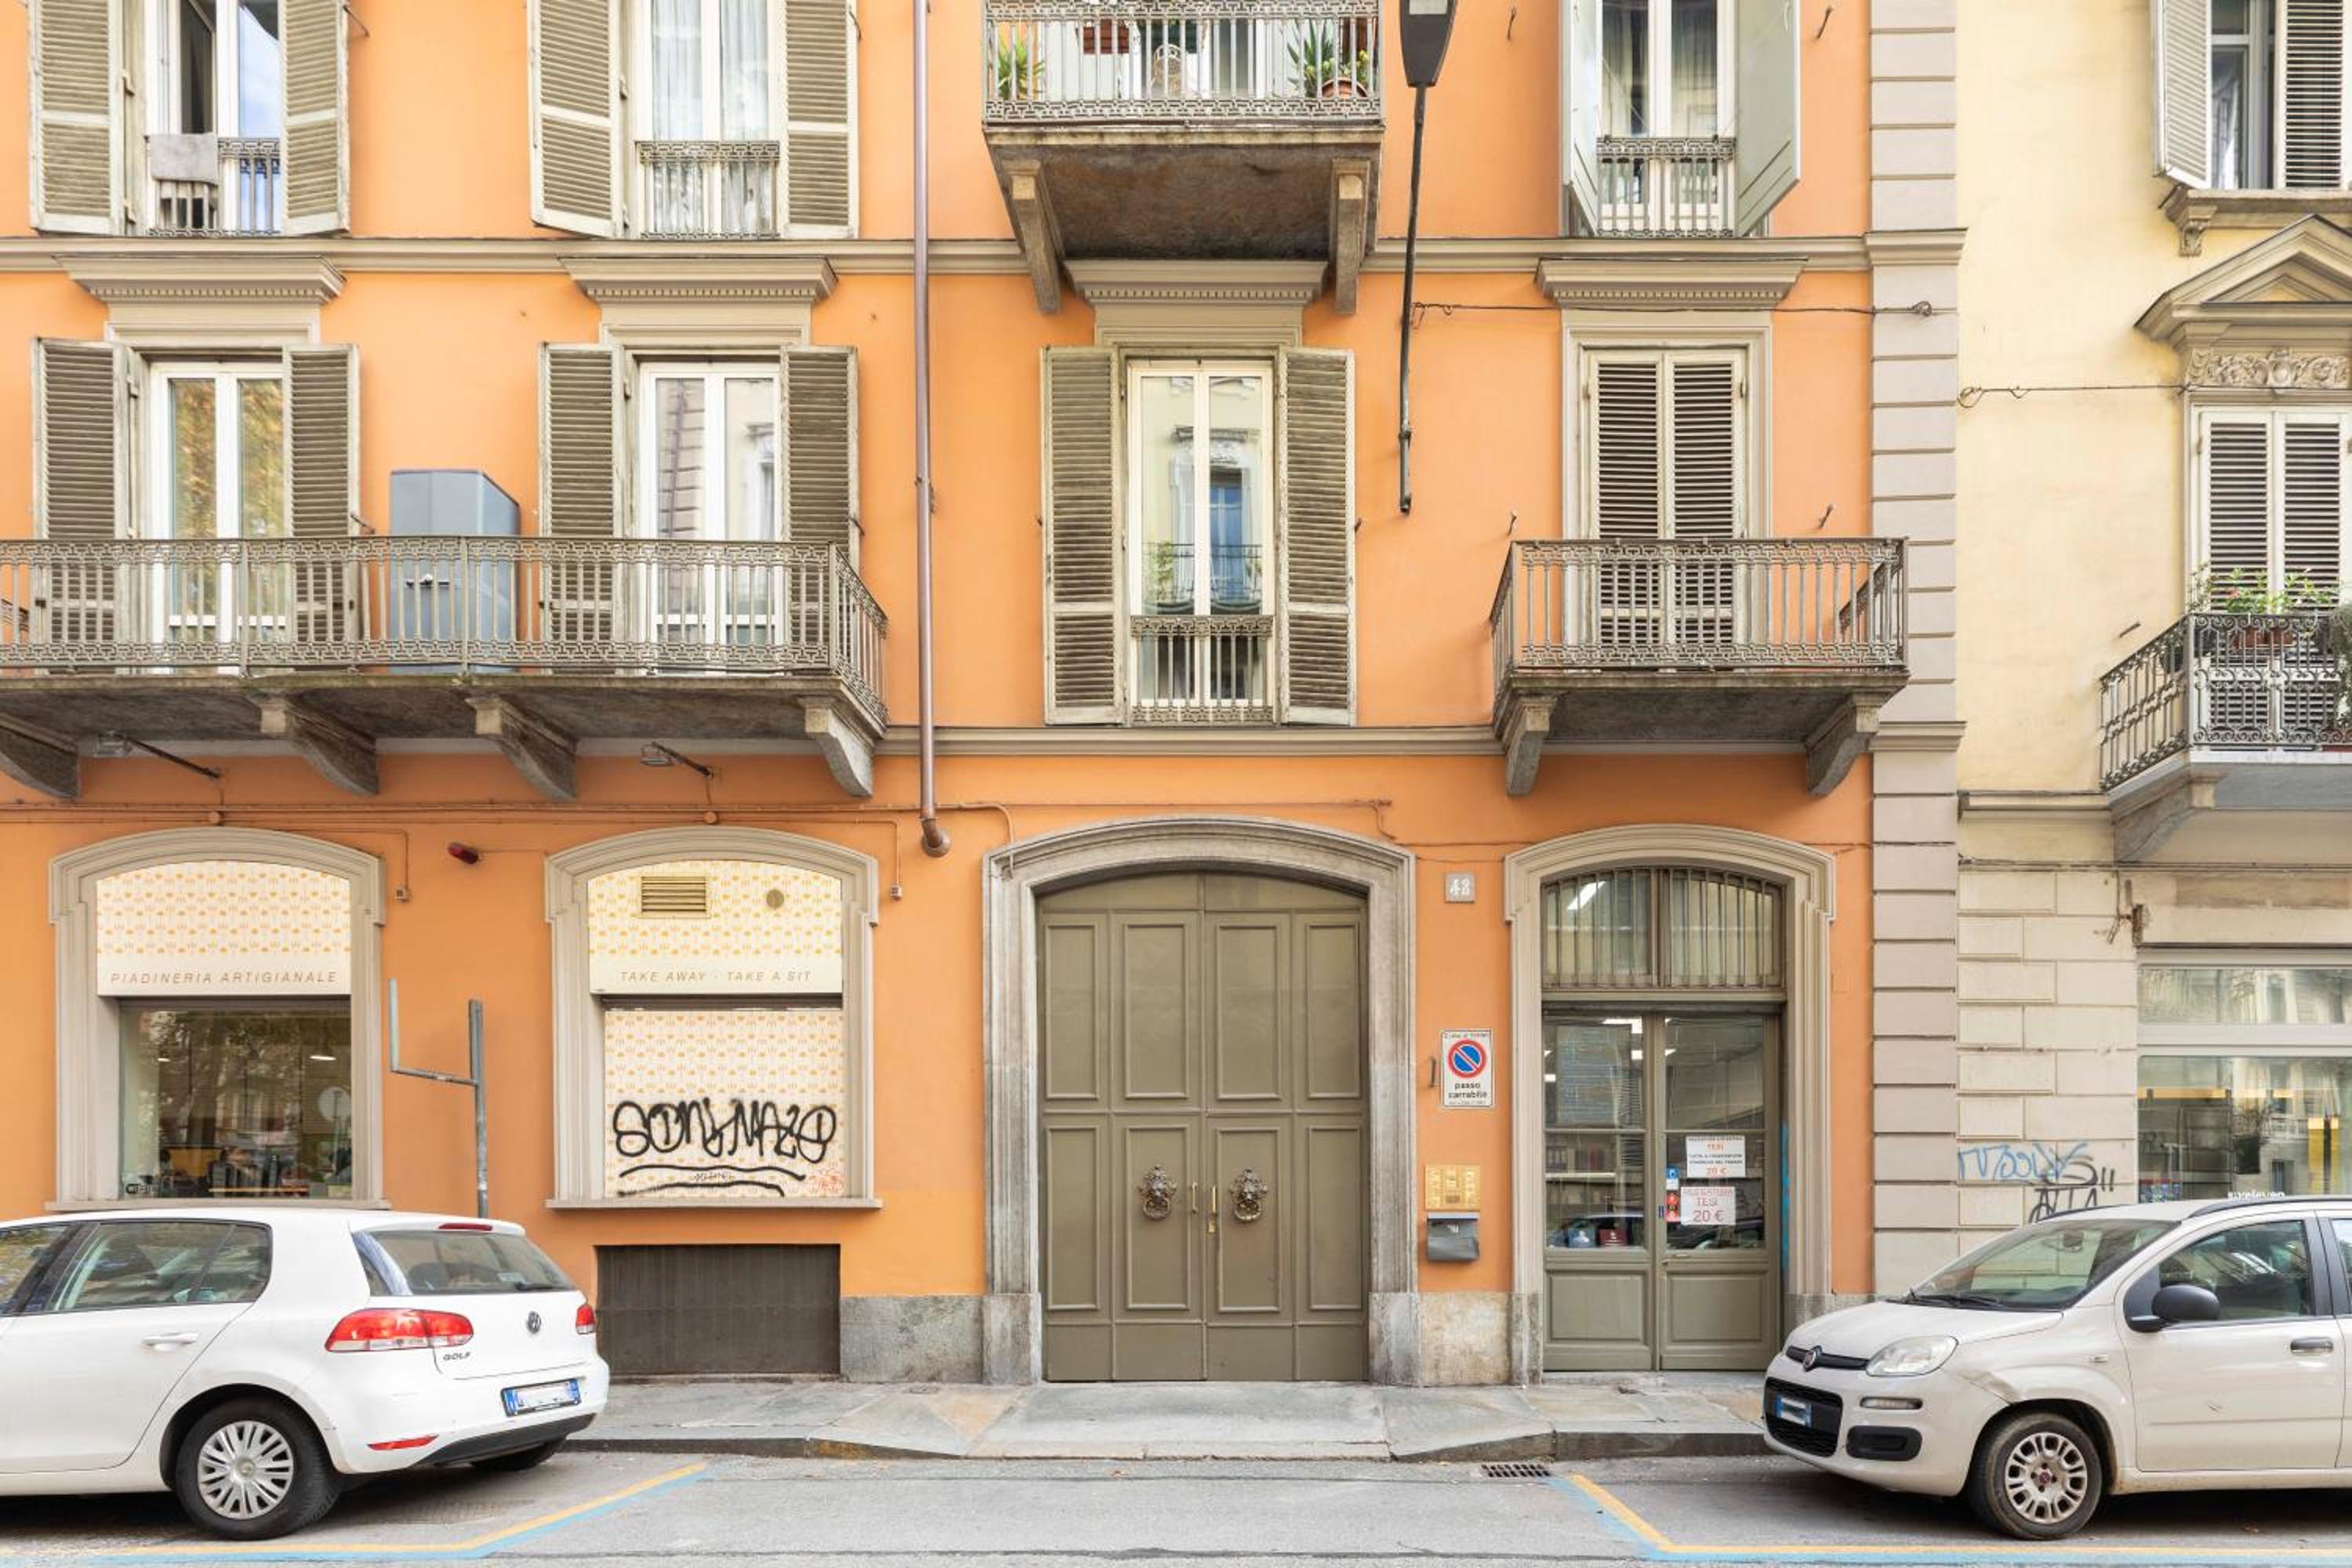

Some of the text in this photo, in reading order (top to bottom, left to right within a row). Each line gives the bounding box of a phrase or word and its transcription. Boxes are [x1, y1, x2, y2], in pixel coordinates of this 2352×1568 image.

[111, 971, 338, 985] PIADINERIA ARTIGIANALE
[620, 971, 659, 982] TAKE
[666, 971, 705, 982] AWAY
[727, 971, 765, 982] TAKE
[770, 971, 780, 982] A
[786, 971, 811, 982] SIT
[1447, 1090, 1488, 1098] carrabile
[1693, 1210, 1726, 1222] 20 €
[443, 1352, 471, 1361] GOLF
